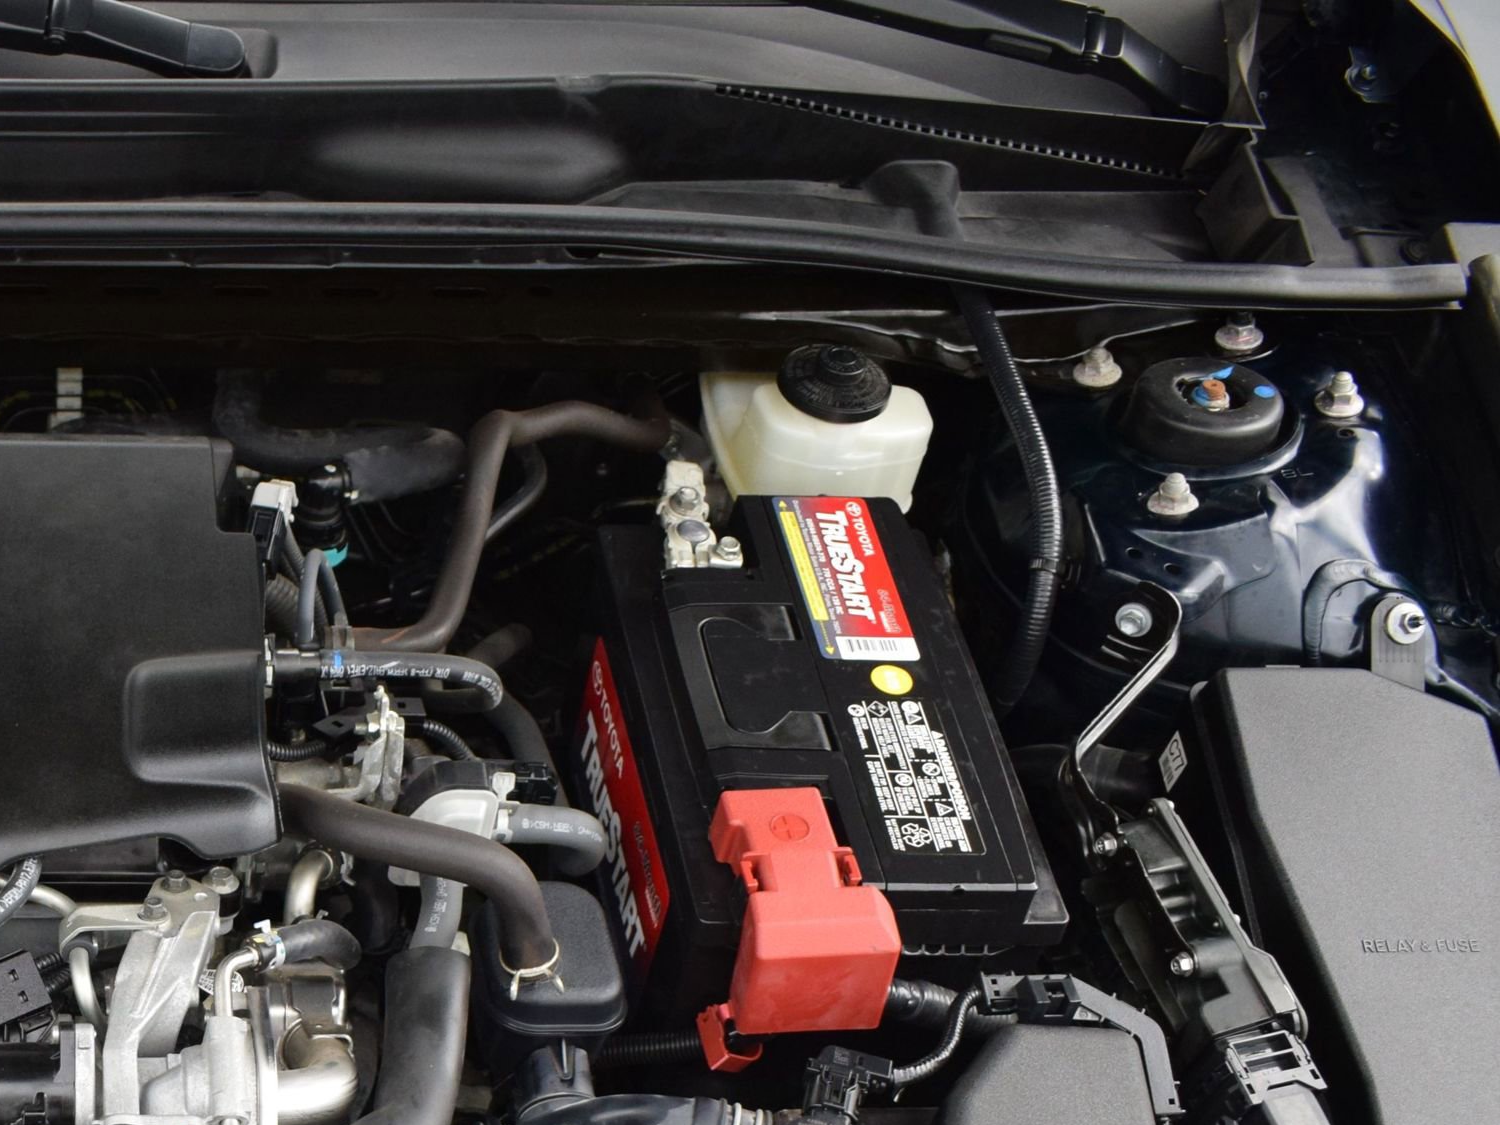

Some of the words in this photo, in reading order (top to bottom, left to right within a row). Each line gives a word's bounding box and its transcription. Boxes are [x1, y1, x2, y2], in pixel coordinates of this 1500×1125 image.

[851, 517, 875, 557] TOYOTA
[600, 696, 625, 779] TOYOTA
[1168, 738, 1185, 771] C77
[1361, 939, 1415, 953] RELAY
[1420, 940, 1432, 952] &
[1435, 939, 1480, 953] FUSE
